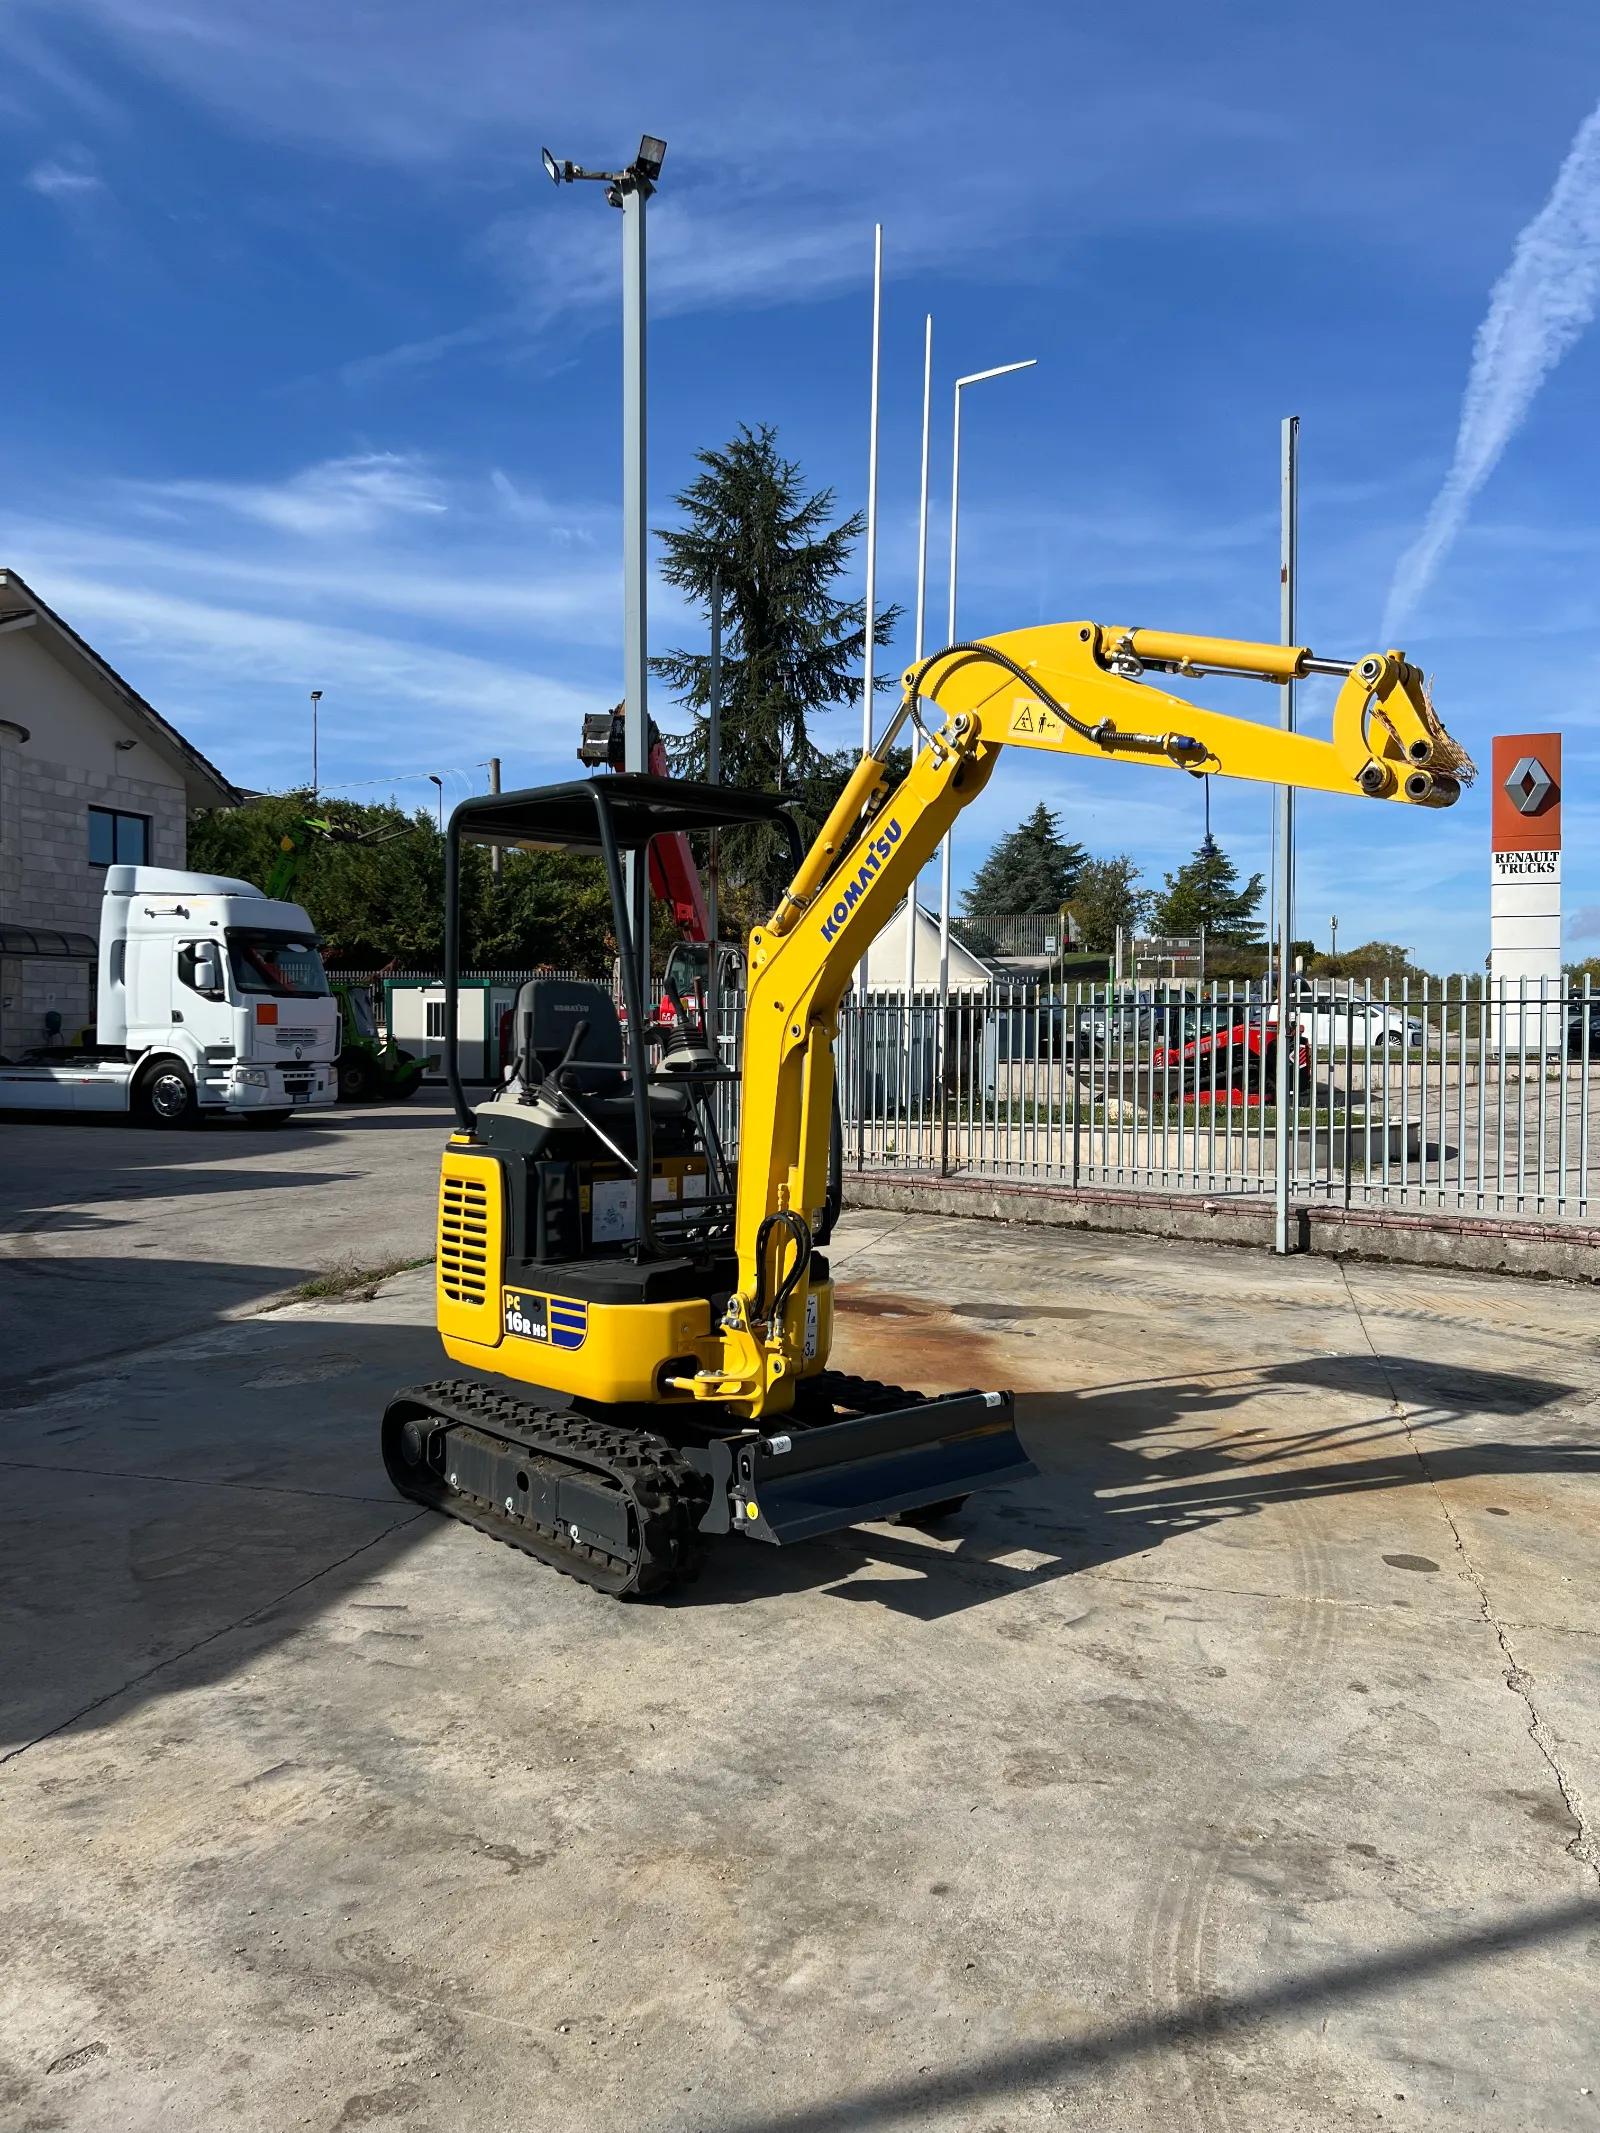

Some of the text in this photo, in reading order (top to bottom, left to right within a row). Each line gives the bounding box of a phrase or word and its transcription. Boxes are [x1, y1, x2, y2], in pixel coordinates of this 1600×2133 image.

[1495, 851, 1560, 864] RENAULT
[1499, 862, 1555, 874] TRUCKS
[820, 817, 902, 943] KOMATSU
[505, 1293, 521, 1311] PC
